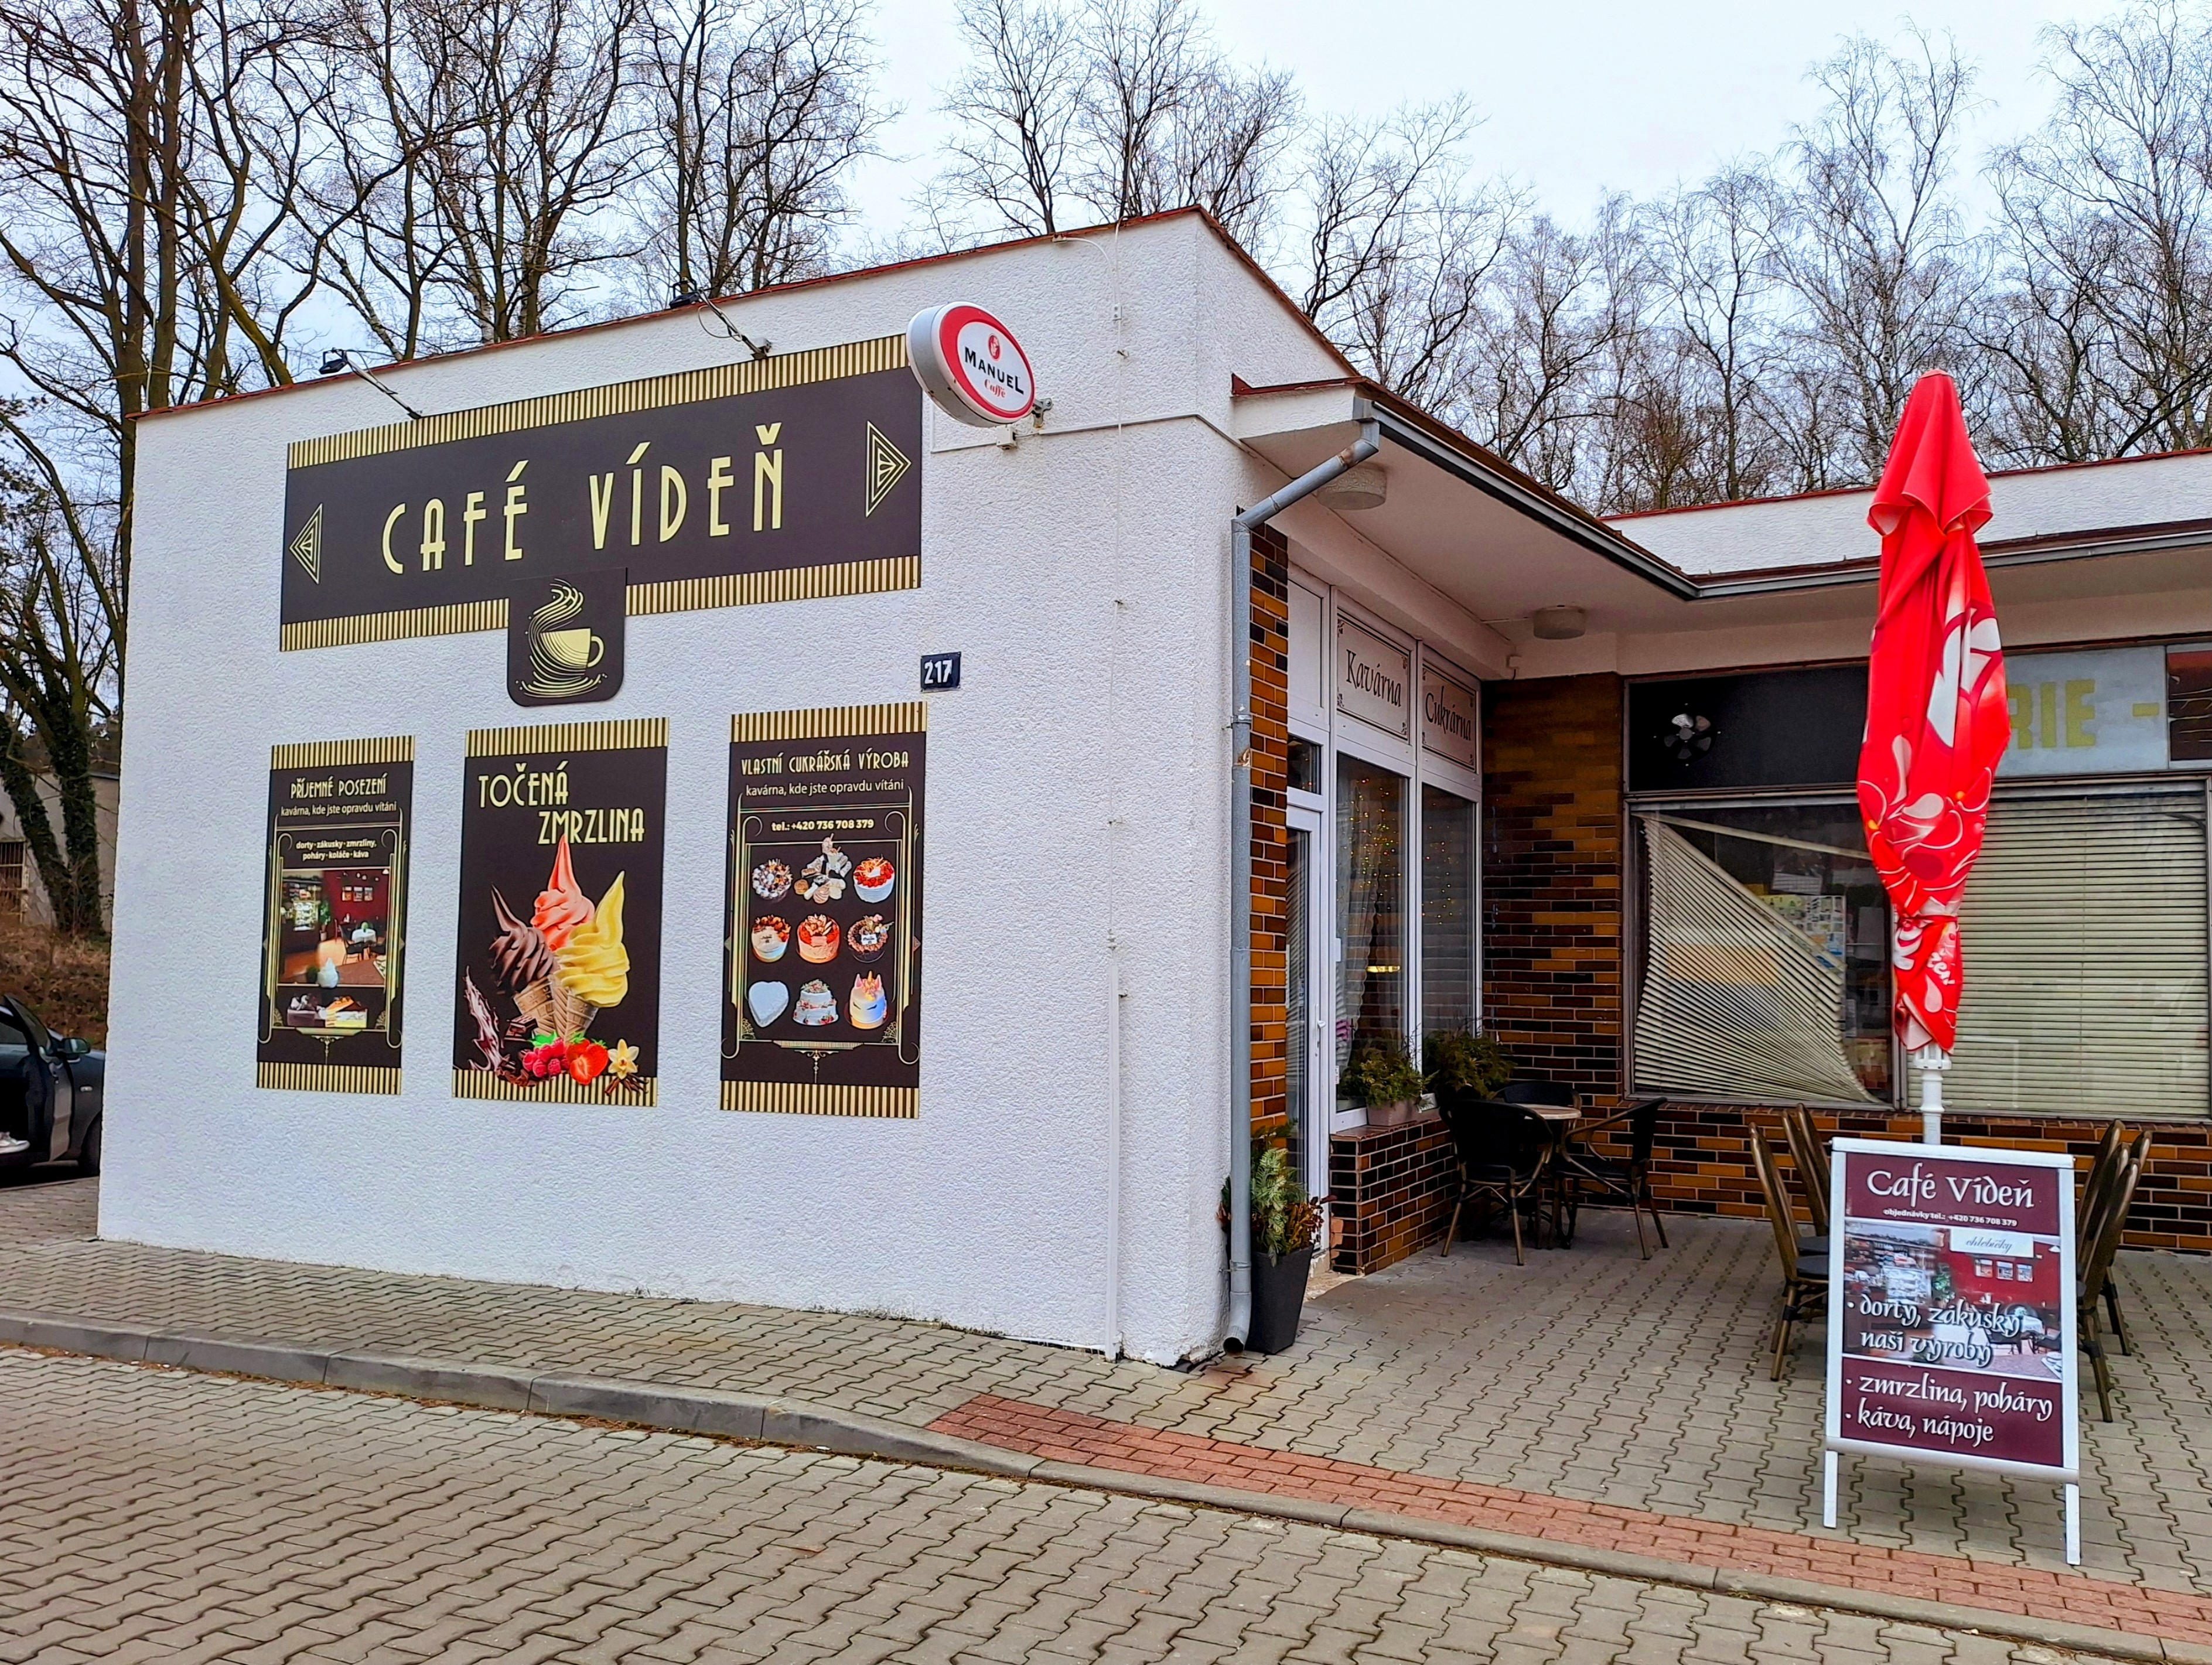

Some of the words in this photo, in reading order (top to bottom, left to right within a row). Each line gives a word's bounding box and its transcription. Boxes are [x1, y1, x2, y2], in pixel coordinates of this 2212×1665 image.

[965, 346, 1024, 395] MANUEL
[383, 460, 528, 574] CAFÉ
[589, 422, 783, 550] VÍDEŇ
[924, 659, 953, 684] 217
[1346, 649, 1402, 708] Kavárna
[1425, 685, 1472, 741] Cukrárna
[741, 752, 784, 775] VLASTNÍ
[788, 749, 851, 773] CUKRÁŘSKÁ
[858, 748, 909, 770] VÝROBA
[291, 776, 334, 799] PŘÍJEMNÉ
[338, 773, 388, 796] POSEZENÍ
[478, 760, 569, 808] TOČENÁ
[746, 784, 787, 797] kavárna,
[789, 783, 807, 794] kde
[808, 783, 828, 796] jste
[830, 780, 872, 795] opravdu
[875, 779, 904, 791] vítáni
[281, 805, 310, 817] kavárna,
[312, 804, 326, 814] kde
[326, 804, 340, 817] jste
[342, 802, 374, 816] opravdu
[375, 801, 397, 813] vítáni
[538, 807, 644, 845] ZMRZLINA
[771, 821, 790, 831] tel.:
[791, 821, 815, 831] +420
[817, 820, 834, 830] 736
[835, 820, 855, 830] 708
[855, 819, 875, 829] 379
[296, 841, 314, 850] dorty
[316, 840, 343, 849] zákusky
[302, 851, 326, 861] poháry
[329, 850, 350, 859] koláče
[353, 849, 369, 858] káva
[1866, 1162, 1937, 1207] Café
[1945, 1175, 2035, 1208] Vídeň
[1883, 1209, 1930, 1220] objednávky
[1948, 1214, 1968, 1222] +420
[1985, 1217, 2001, 1225] 708
[2002, 1219, 2018, 1227] 379
[1859, 1294, 1922, 1328] dorty,
[1927, 1298, 2021, 1337] zákusky
[1859, 1330, 1904, 1351] naší
[1910, 1331, 1992, 1367] výroby
[1858, 1372, 1968, 1411] zmrzlina,
[1974, 1381, 2054, 1421] poháry
[1857, 1397, 1917, 1439] káva,
[1922, 1415, 1995, 1448] nápoje
